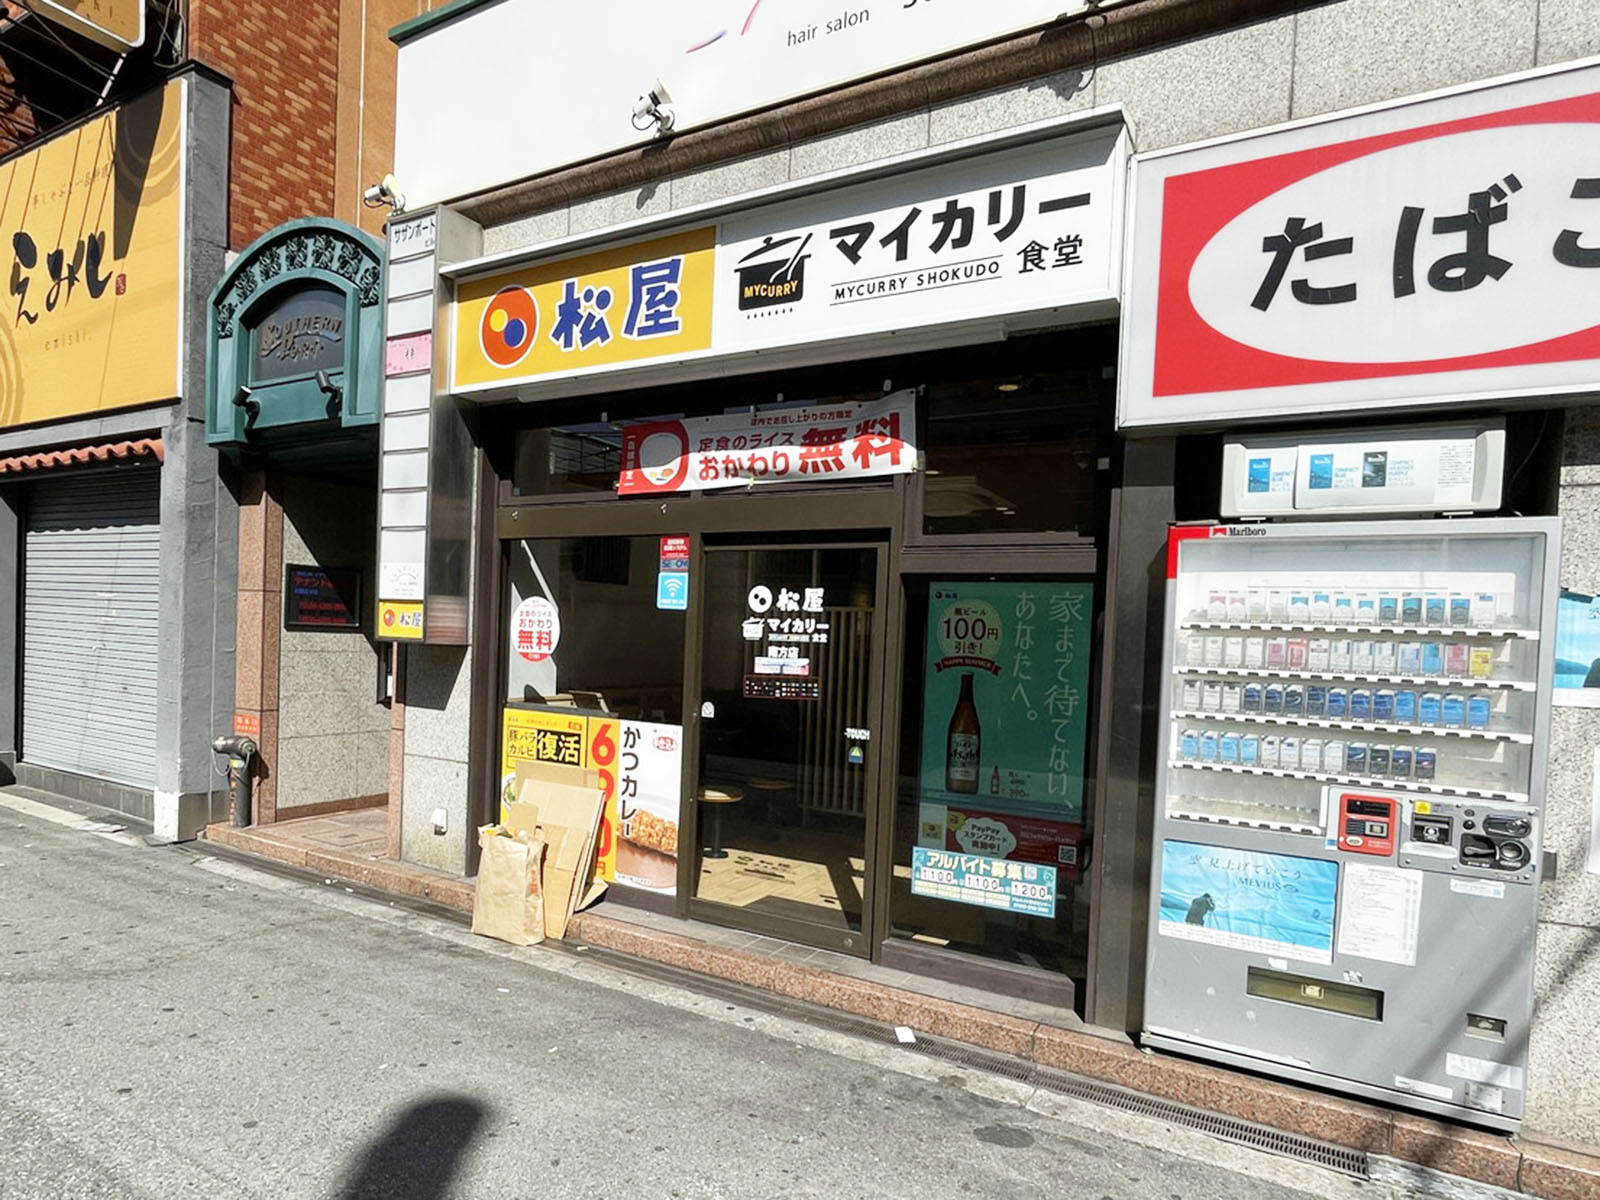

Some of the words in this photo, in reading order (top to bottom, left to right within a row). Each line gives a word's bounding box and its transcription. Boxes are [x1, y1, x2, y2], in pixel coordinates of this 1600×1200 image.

[787, 24, 818, 47] hair
[826, 9, 870, 35] salon
[394, 219, 436, 243] サザンポート
[828, 184, 1091, 265] マイカリー
[1016, 234, 1084, 275] 食堂
[743, 279, 799, 299] MYCURRY
[834, 276, 908, 300] MYCURRY
[916, 261, 1001, 287] SHOKUDO
[549, 256, 684, 351] 松屋
[699, 430, 794, 452] 定食のライス
[799, 411, 904, 474] 無料
[698, 449, 790, 481] おかわり
[1228, 526, 1266, 536] Marlboro
[775, 587, 824, 612] 松屋
[400, 611, 421, 627] 松屋
[766, 618, 829, 633] マイカリー
[943, 618, 999, 640] 100円
[518, 629, 553, 651] 無料
[1011, 591, 1038, 721] あなたへ。
[1044, 591, 1084, 809] 家まで待てない、
[537, 731, 580, 763] 復活
[620, 726, 641, 837] かつカレー
[926, 851, 1023, 881] アルバイト募集
[1238, 876, 1282, 891] MEVIUS
